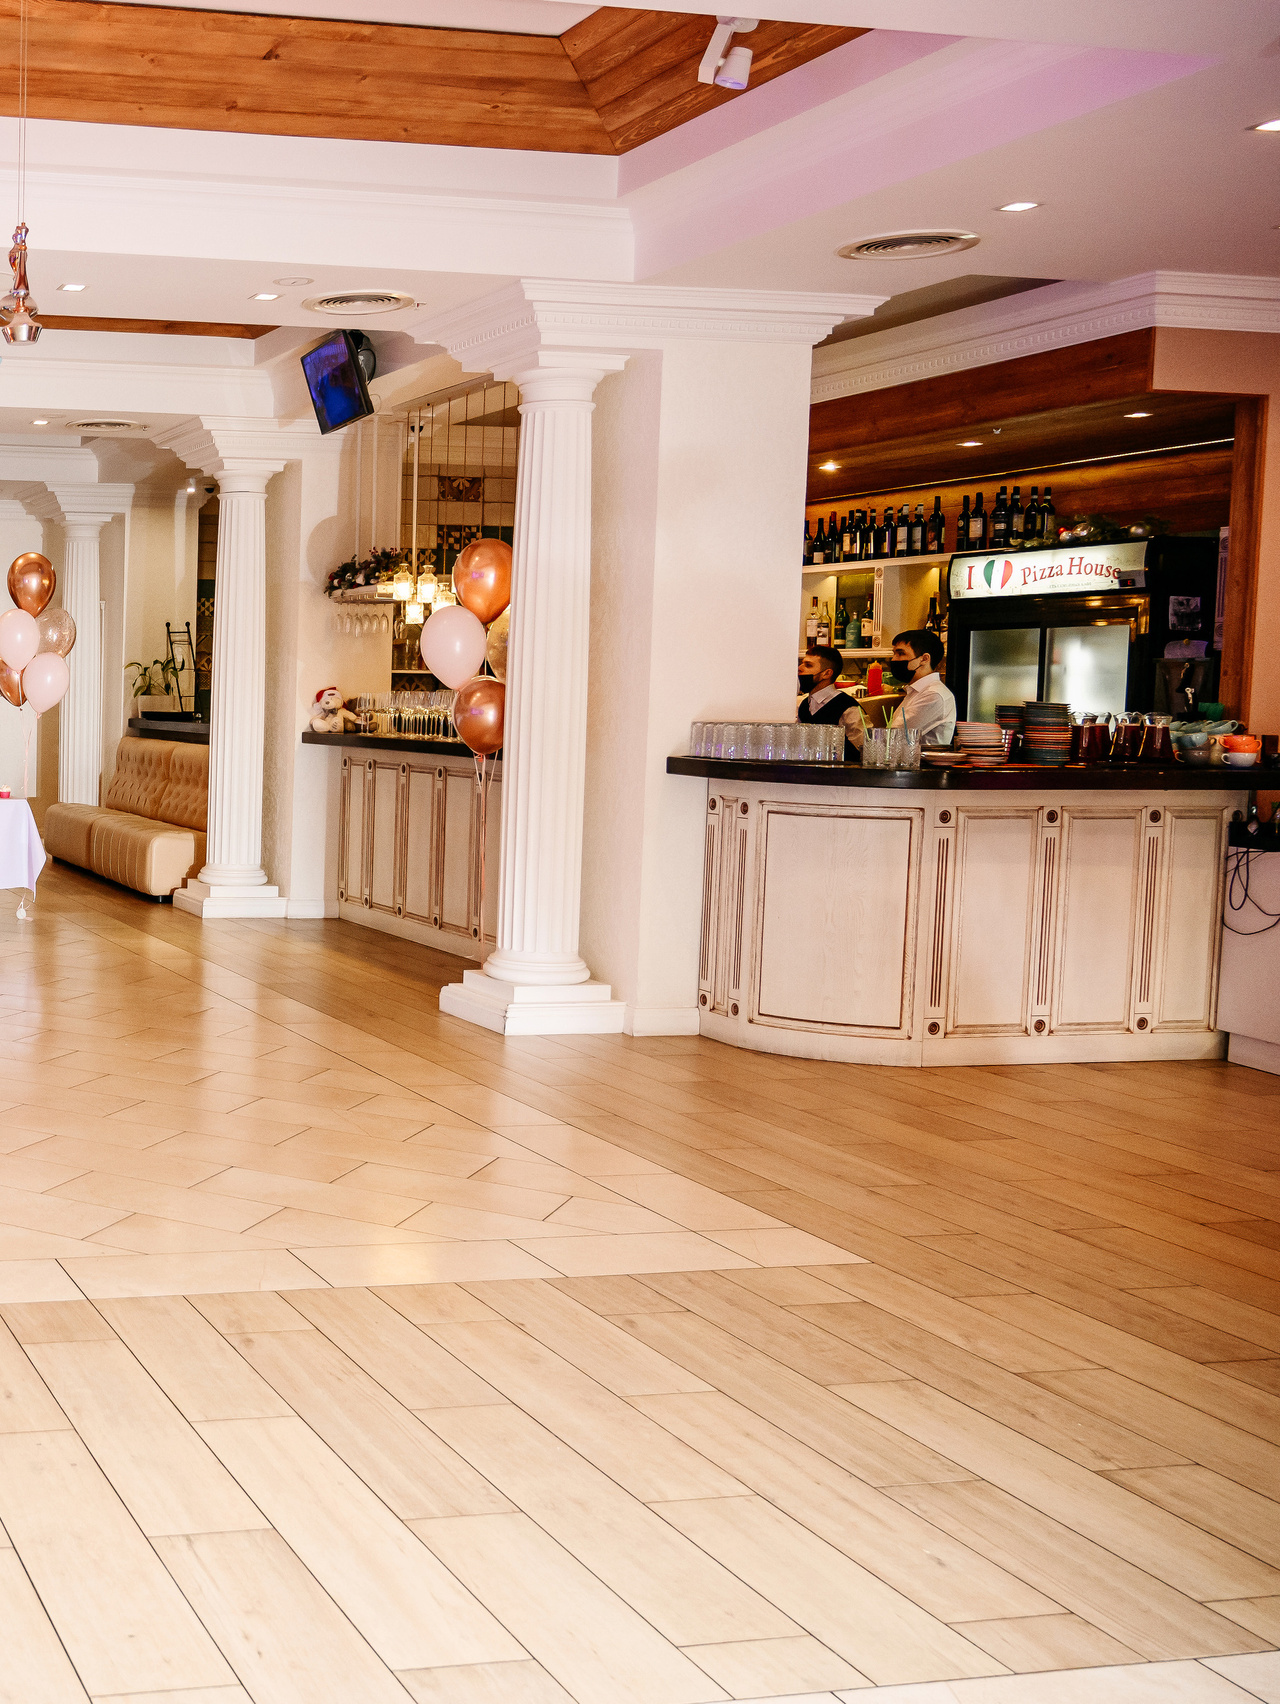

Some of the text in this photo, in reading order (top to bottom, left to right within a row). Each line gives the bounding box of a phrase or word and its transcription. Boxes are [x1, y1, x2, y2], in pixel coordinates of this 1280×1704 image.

[966, 556, 1121, 590] I Pizza House
